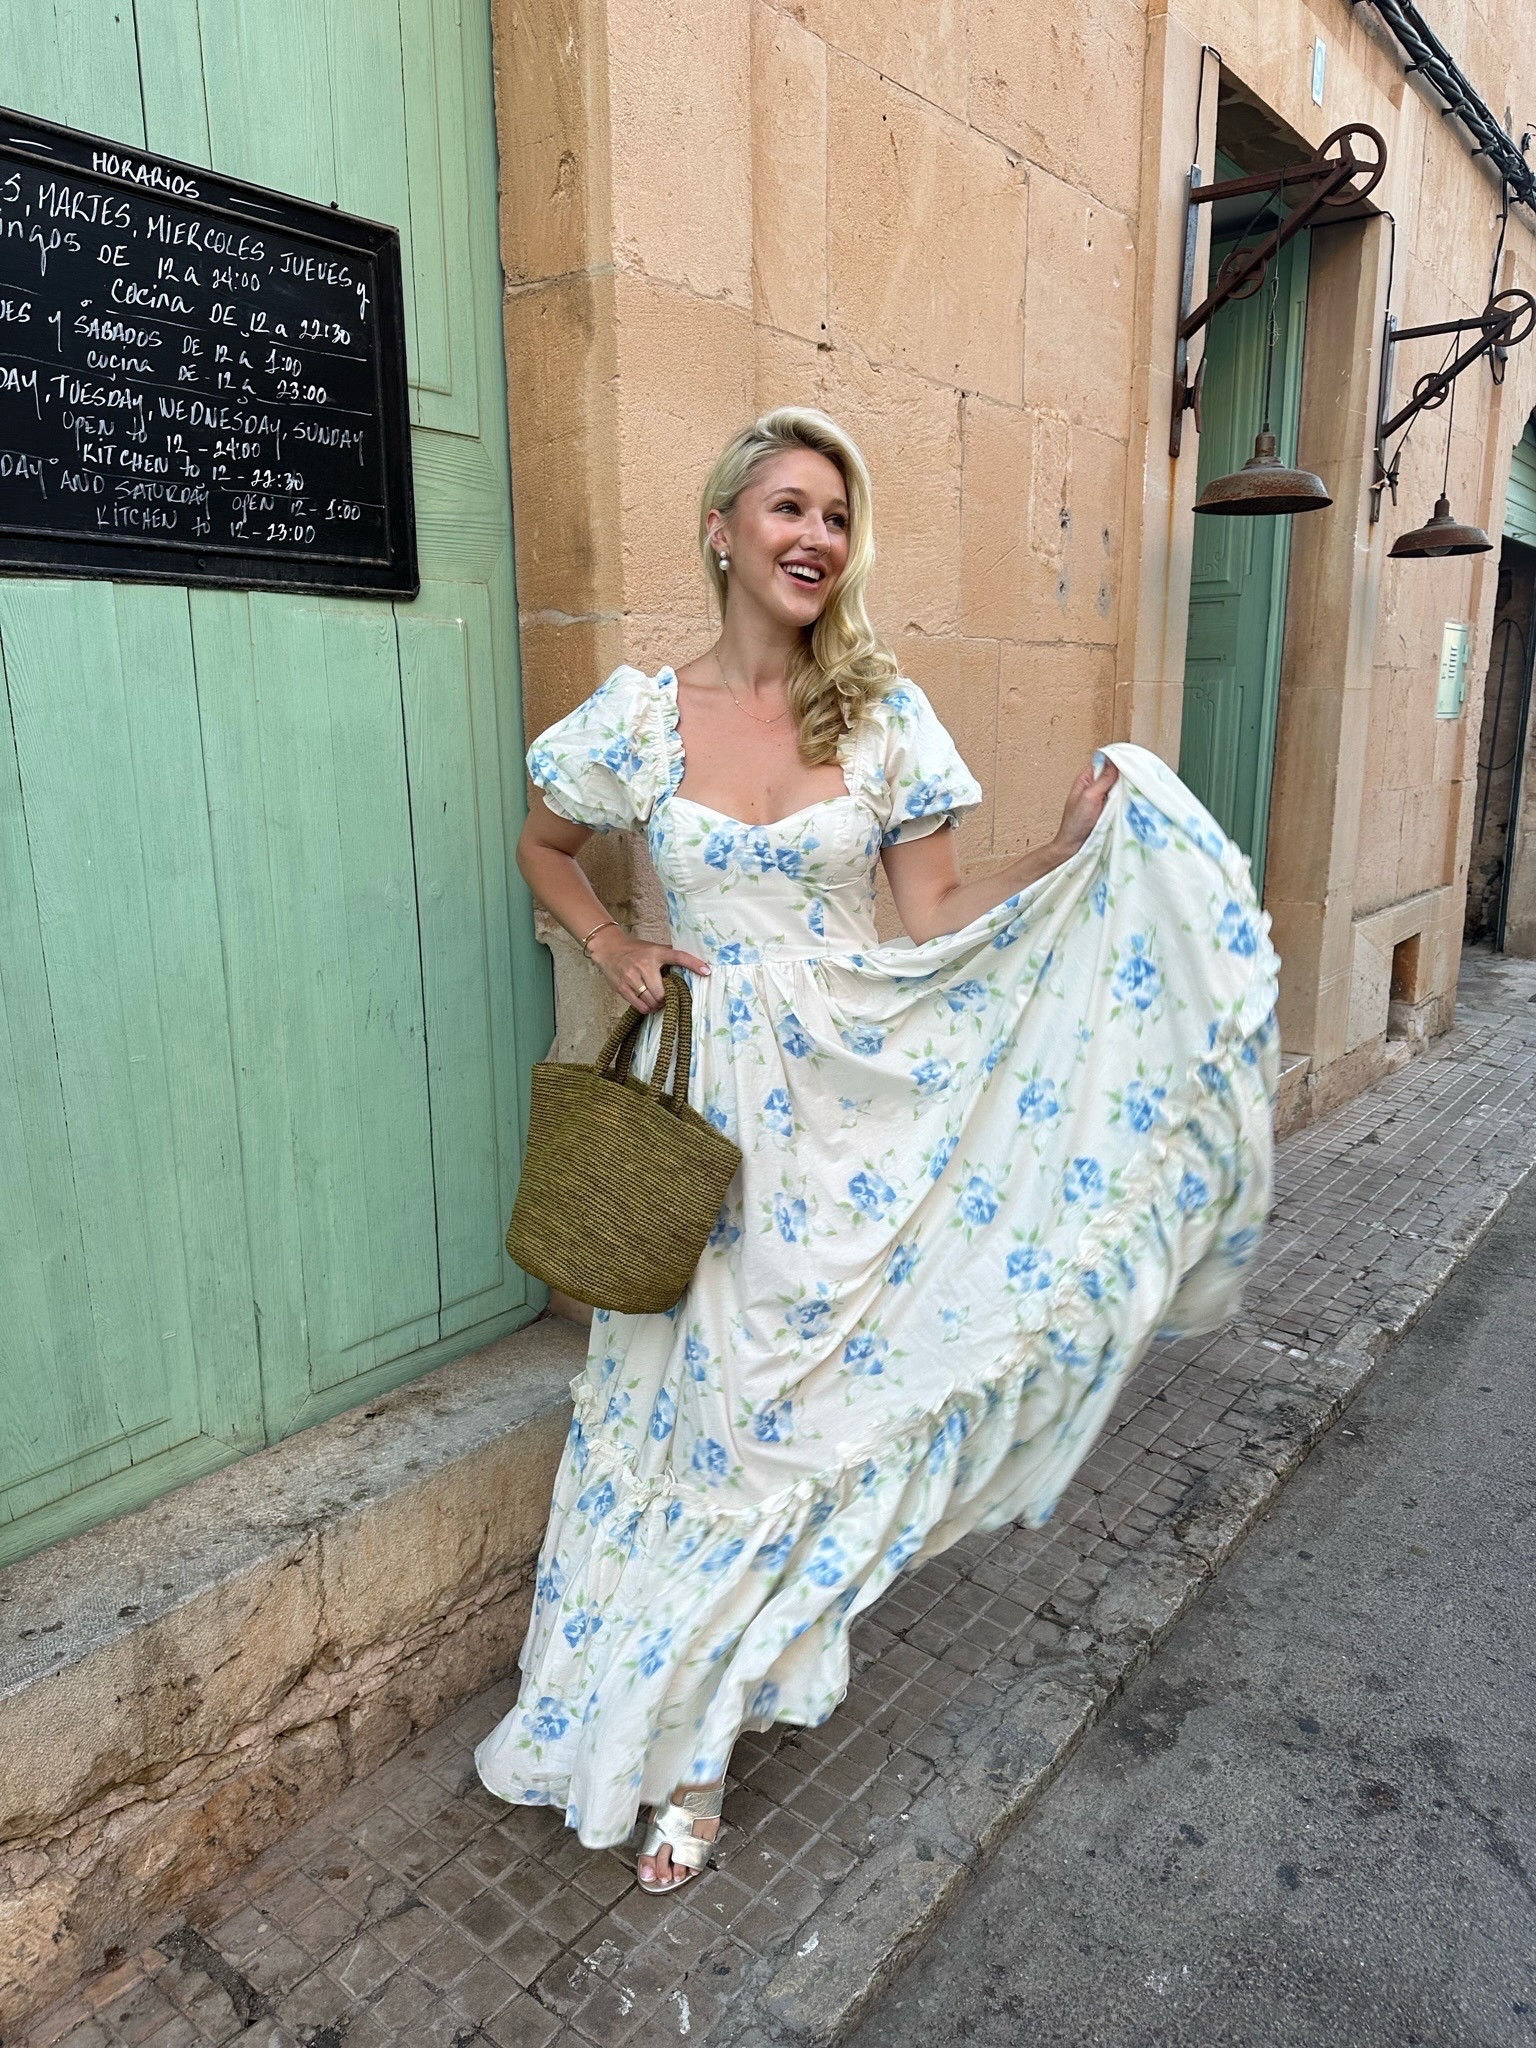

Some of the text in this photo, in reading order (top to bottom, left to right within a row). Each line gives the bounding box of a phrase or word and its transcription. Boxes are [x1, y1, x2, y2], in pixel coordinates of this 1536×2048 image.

[38, 182, 137, 238] MARTES,
[280, 252, 353, 288] JUEVES
[97, 244, 131, 267] DE
[158, 257, 180, 283] 12
[212, 265, 261, 292] 24:00
[74, 315, 163, 348] SABADOS
[181, 336, 204, 356] DE
[214, 344, 233, 363] 12
[239, 350, 254, 369] a
[264, 349, 302, 377] 1:00
[209, 302, 238, 326] DE
[250, 311, 270, 333] 12
[275, 323, 289, 338] a
[299, 319, 351, 345] 22:30
[178, 364, 199, 381] DE
[218, 371, 236, 389] 12
[241, 378, 257, 395] a
[275, 379, 327, 404] 23:00
[126, 416, 148, 444] to
[167, 434, 188, 454] 12
[213, 437, 261, 460] 24:00
[293, 421, 364, 467] SUNDAY
[60, 469, 105, 494] AND
[115, 480, 210, 520] SATURDAY
[290, 499, 307, 517] 12
[325, 498, 361, 521] 1:00
[180, 455, 200, 478] to
[212, 464, 231, 481] 12
[251, 469, 304, 491] 22:30
[191, 516, 211, 537] to
[230, 520, 249, 539] 12
[266, 523, 316, 544] 23:00
